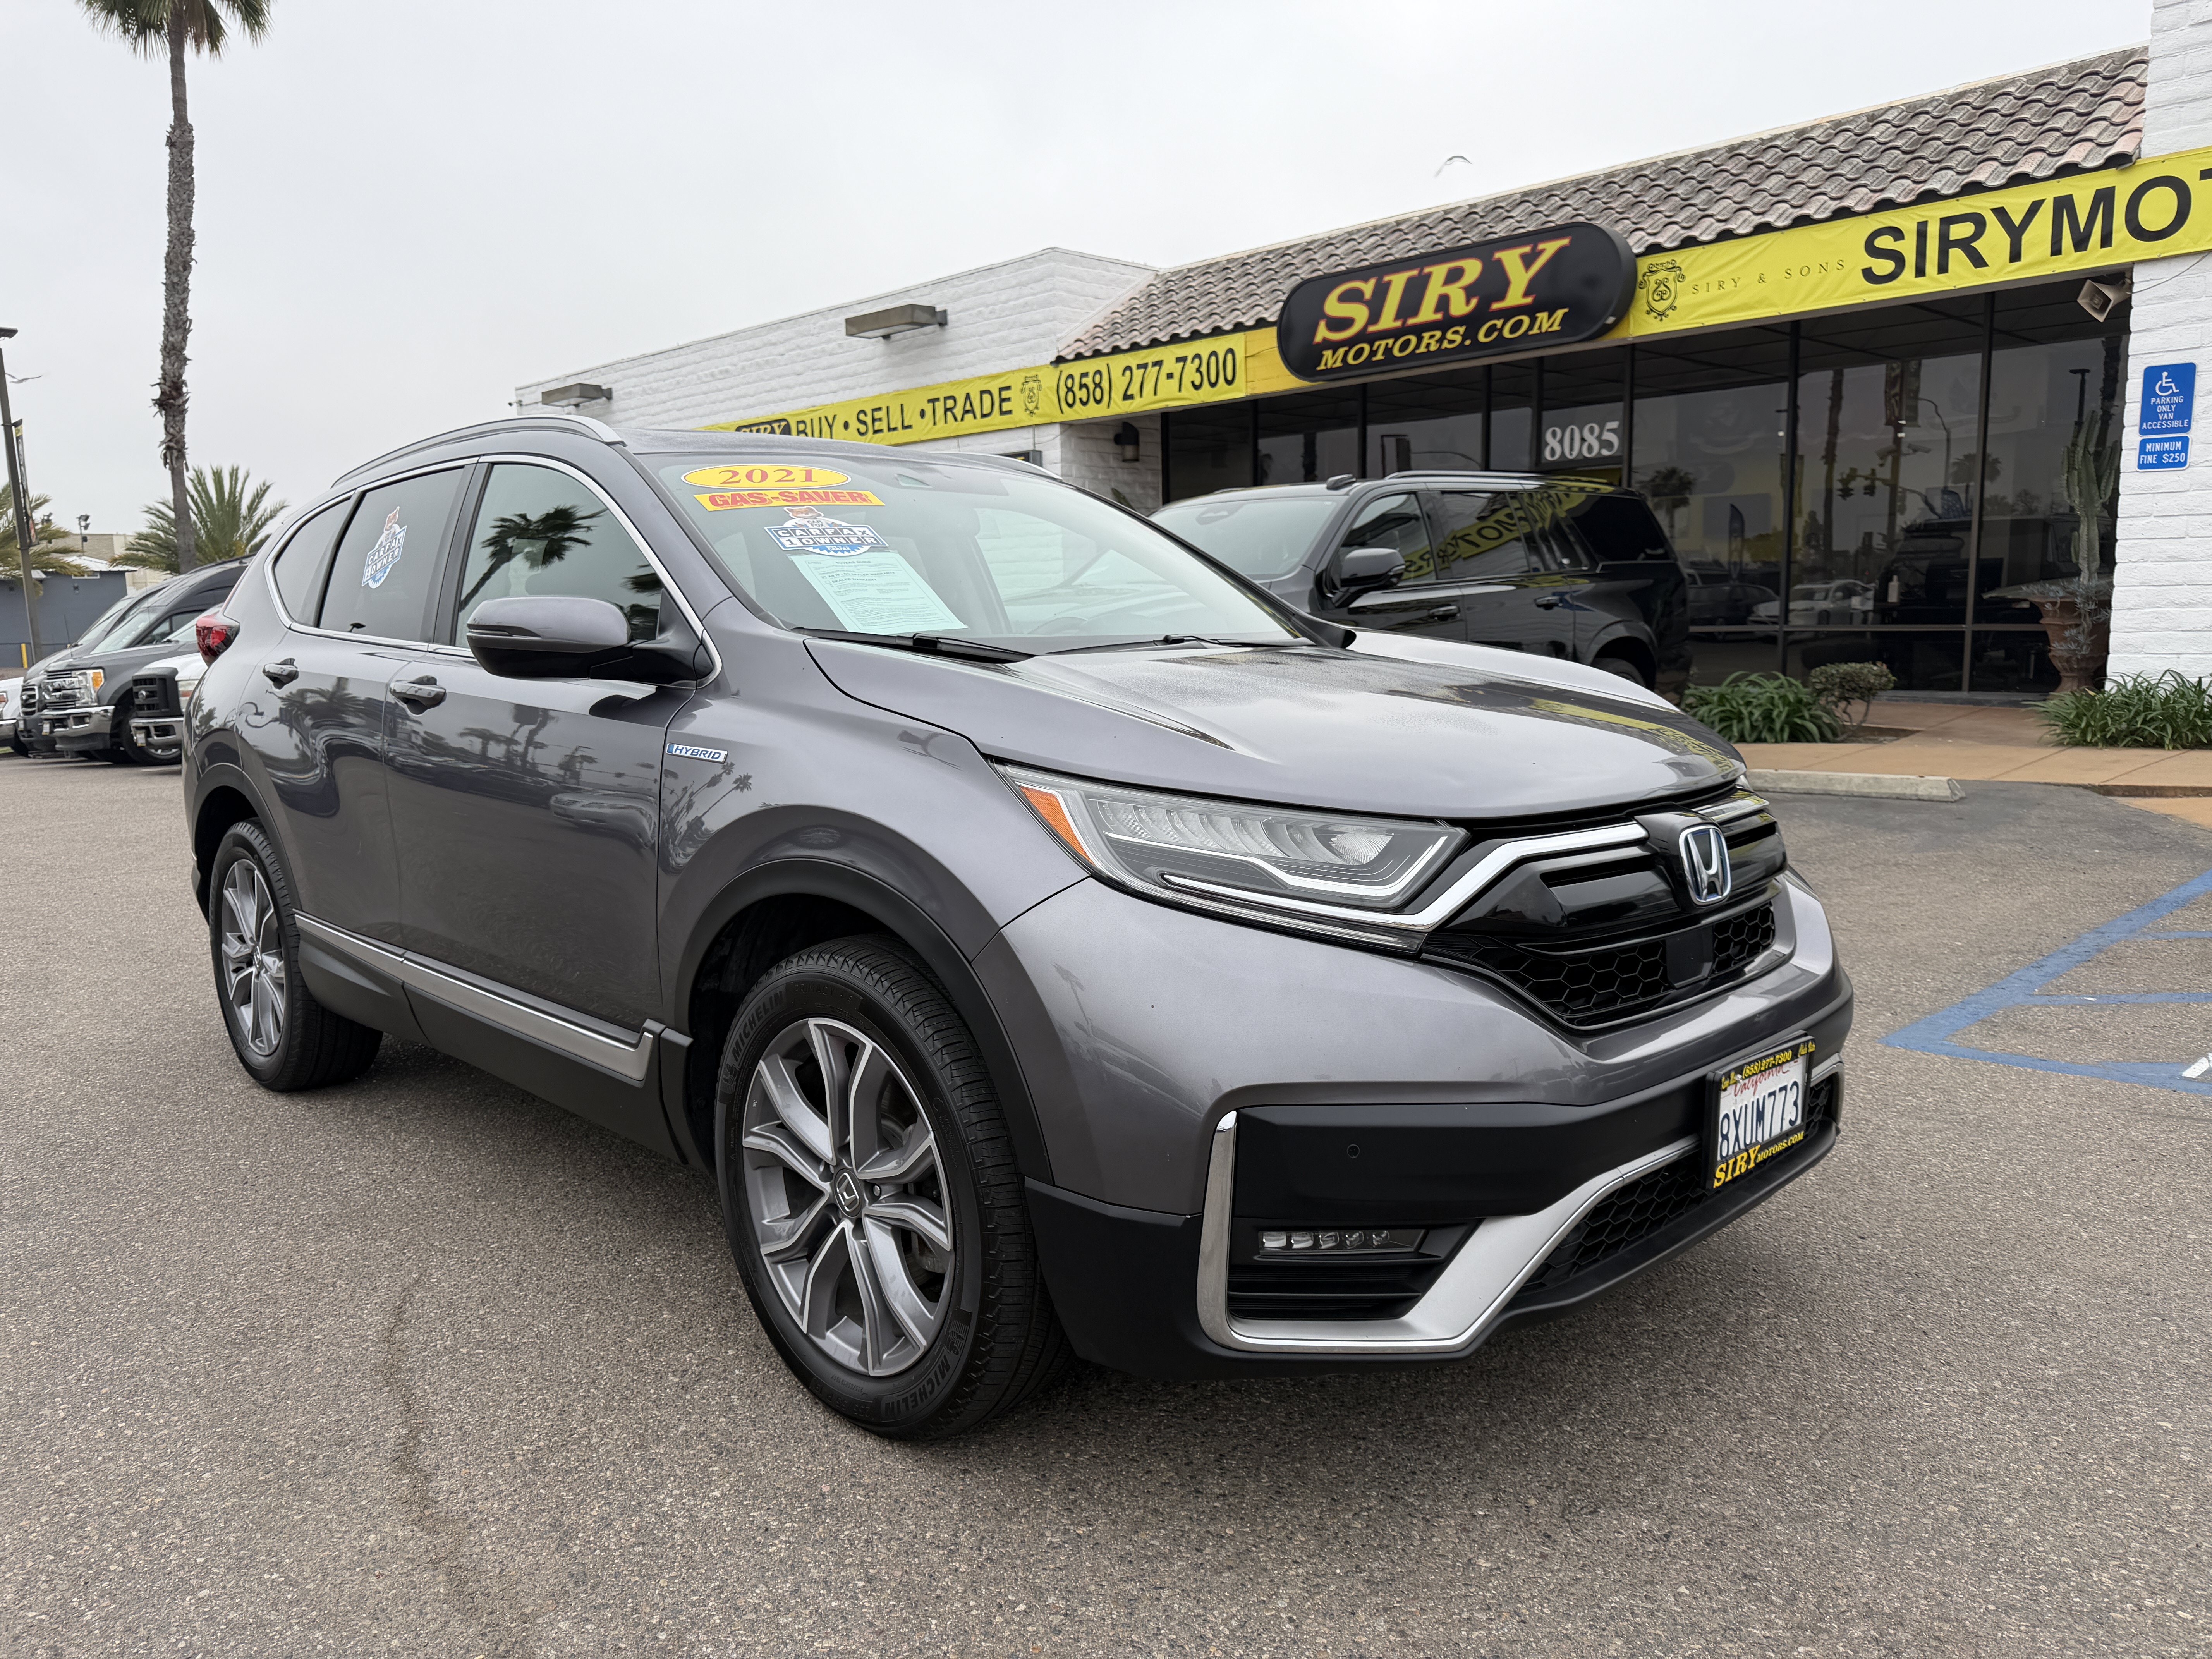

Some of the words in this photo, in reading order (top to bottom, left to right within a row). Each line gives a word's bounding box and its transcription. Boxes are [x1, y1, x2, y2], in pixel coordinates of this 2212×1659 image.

[1861, 168, 2212, 286] SIRYMO
[1312, 236, 1572, 344] SIRY
[1692, 276, 1741, 295] SIRY
[1757, 273, 1767, 283] &
[1784, 259, 1845, 280] SONS
[1316, 308, 1570, 371] MOTORS.COM
[1056, 363, 1113, 415] (858)
[1121, 347, 1237, 402] 277-7300
[796, 414, 837, 439] BUY
[856, 403, 913, 437] SELL
[927, 386, 1013, 426] TRADE
[2150, 395, 2184, 405] PARKING
[2157, 404, 2176, 412] ONLY
[2141, 419, 2189, 429] ACCESSIBLE
[1544, 421, 1620, 461] 8085
[2146, 441, 2182, 452] MINIMUM
[2139, 454, 2157, 464] FINE
[2162, 453, 2186, 464] $250
[718, 468, 819, 485] 2021
[708, 491, 871, 507] GAS-SAVER
[777, 528, 870, 537] CARFAX
[801, 537, 878, 545] OWNER
[369, 534, 403, 565] CARFAX
[371, 548, 399, 574] OWNER
[674, 746, 721, 759] HYBRID
[732, 991, 784, 1063] MICHELIN
[1719, 1081, 1800, 1161] 8XUM773
[1713, 1144, 1761, 1189] SIRY
[1757, 1130, 1805, 1163] MOTORS.COM
[883, 1354, 951, 1417] MICHELIN
